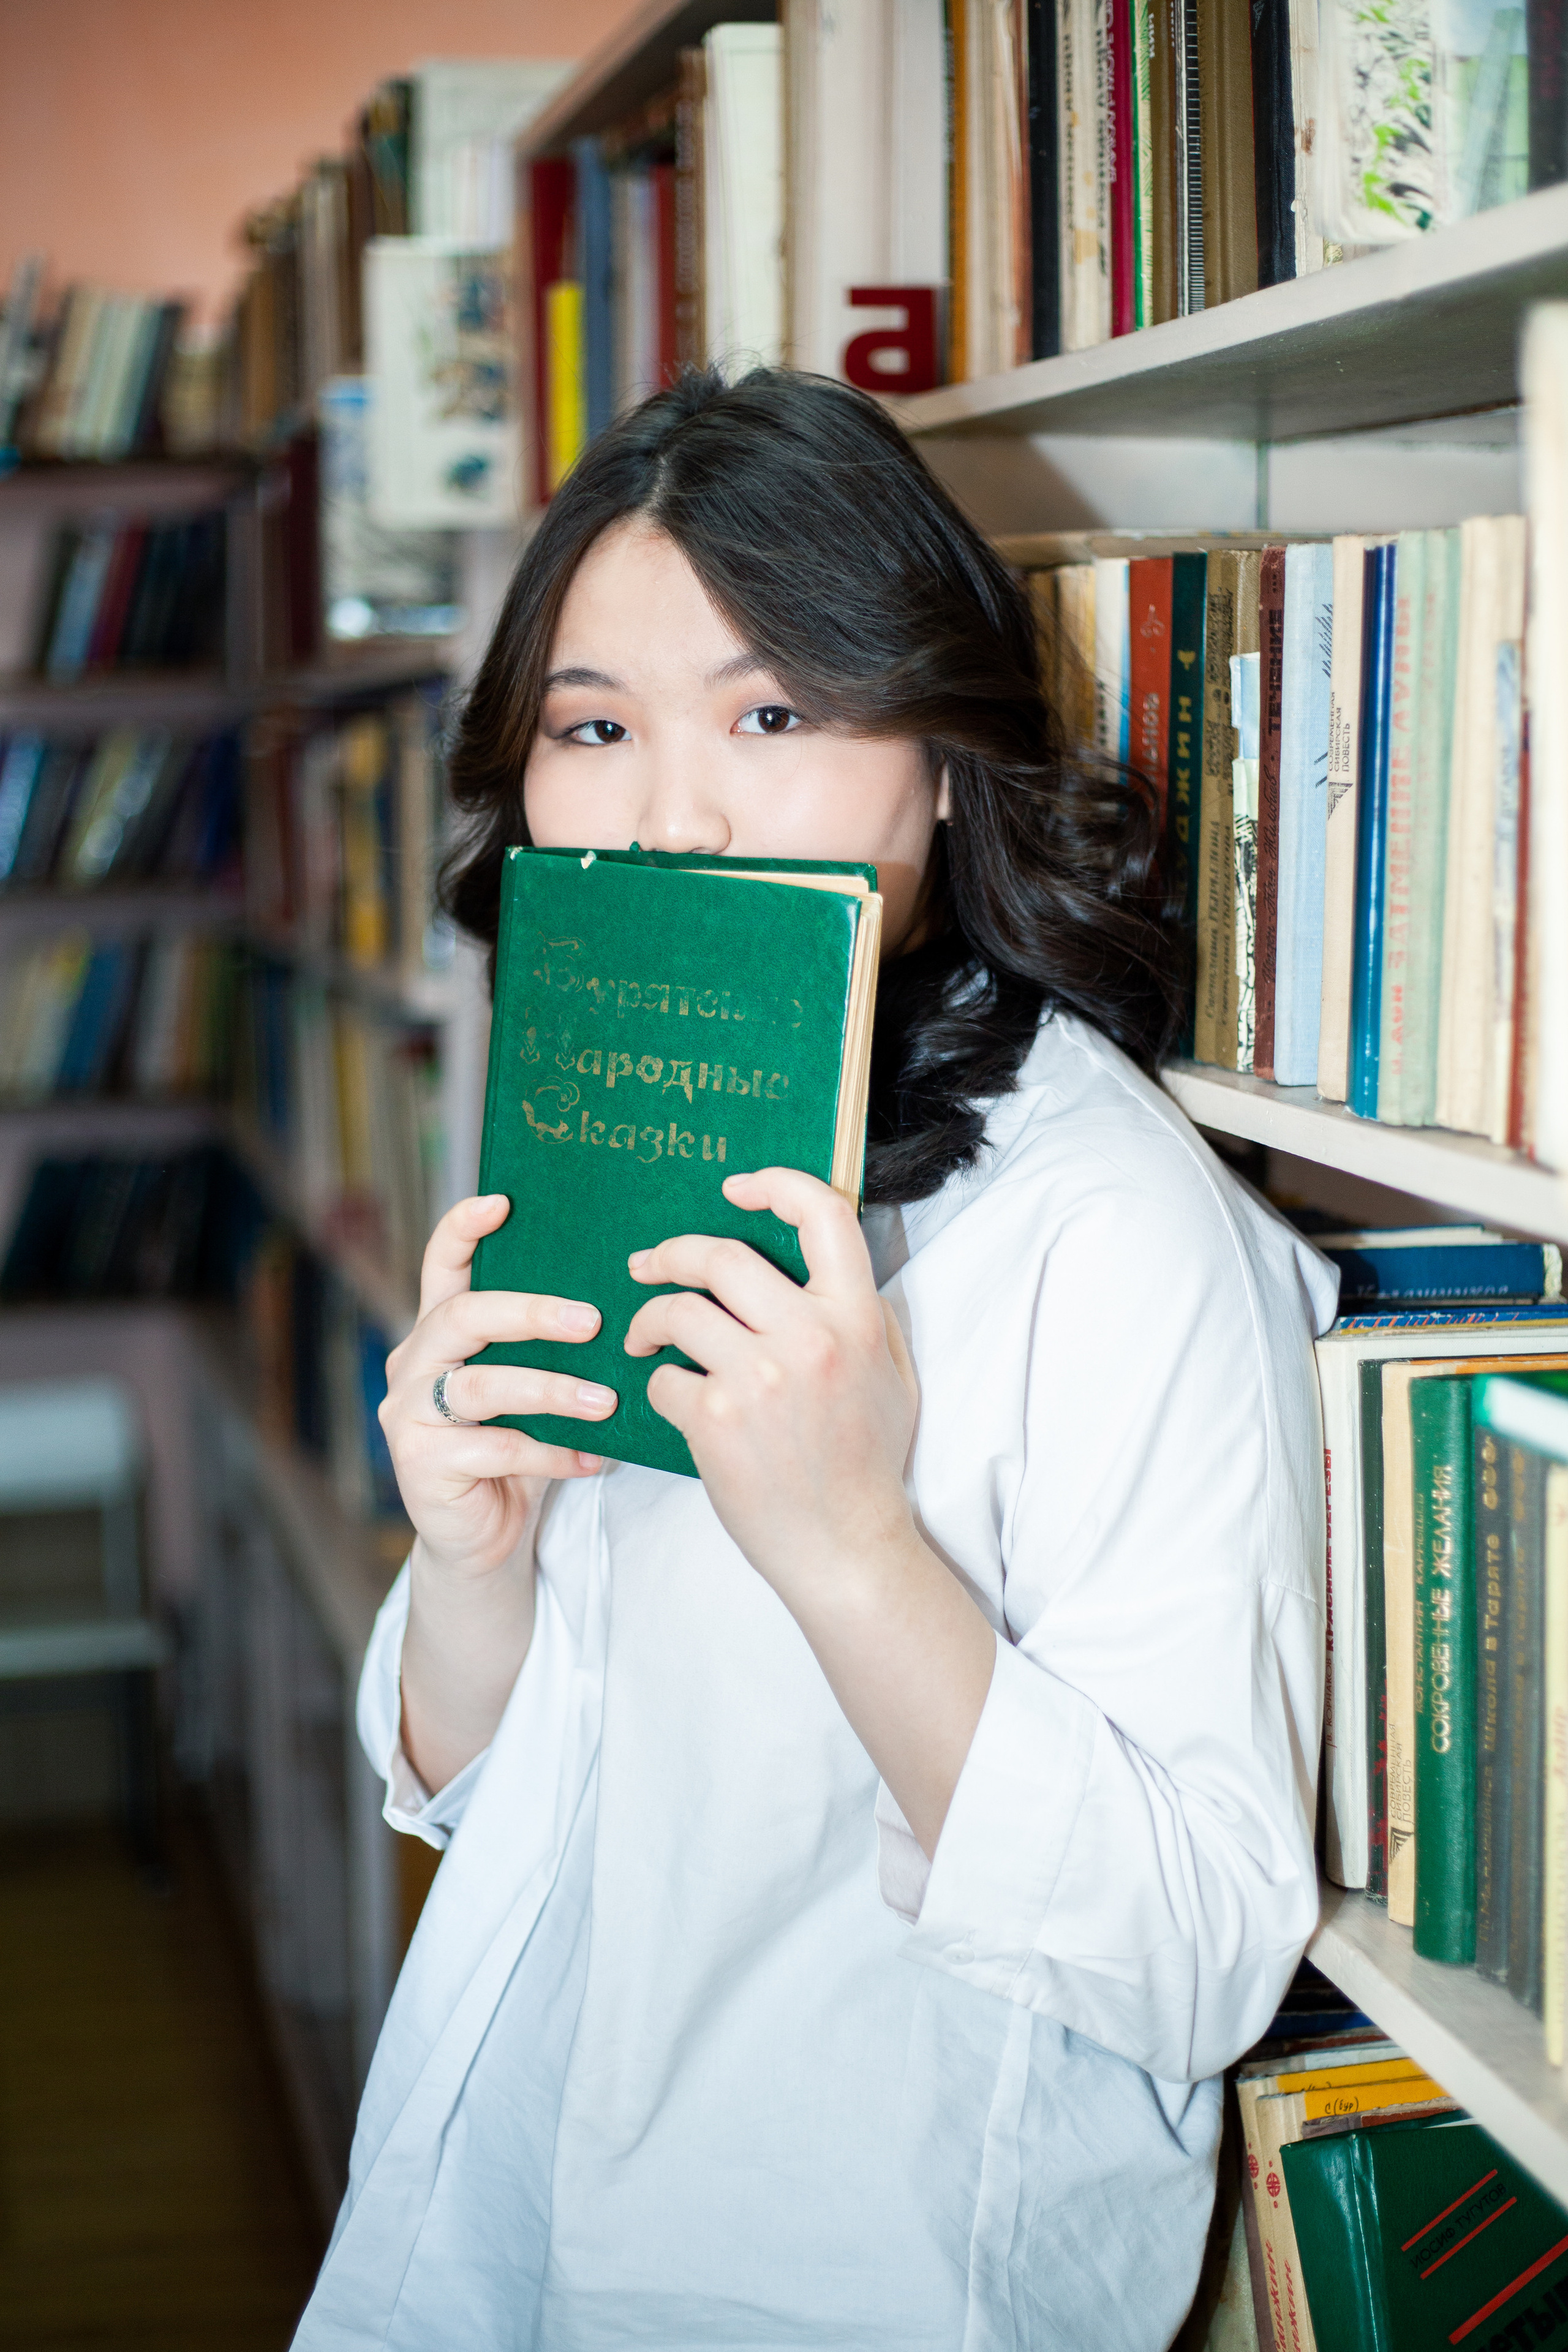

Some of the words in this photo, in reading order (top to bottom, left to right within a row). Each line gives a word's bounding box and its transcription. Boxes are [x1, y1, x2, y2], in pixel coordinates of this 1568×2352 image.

[1267, 608, 1283, 737] ТЕЧЕНИЕ
[1341, 722, 1351, 772] ПОВЕСТЬ
[522, 1076, 726, 1164] Сказки
[1431, 1464, 1452, 1578] ЖЕЛАНИЯ
[1430, 1588, 1452, 1754] СОКРОВЕННЫЕ
[1485, 1636, 1499, 1651] в
[1401, 1759, 1412, 1823] ПОВЕСТЬ
[1409, 2227, 1457, 2269] ИОСИФ
[1454, 2182, 1507, 2230] ТУГУТОВ
